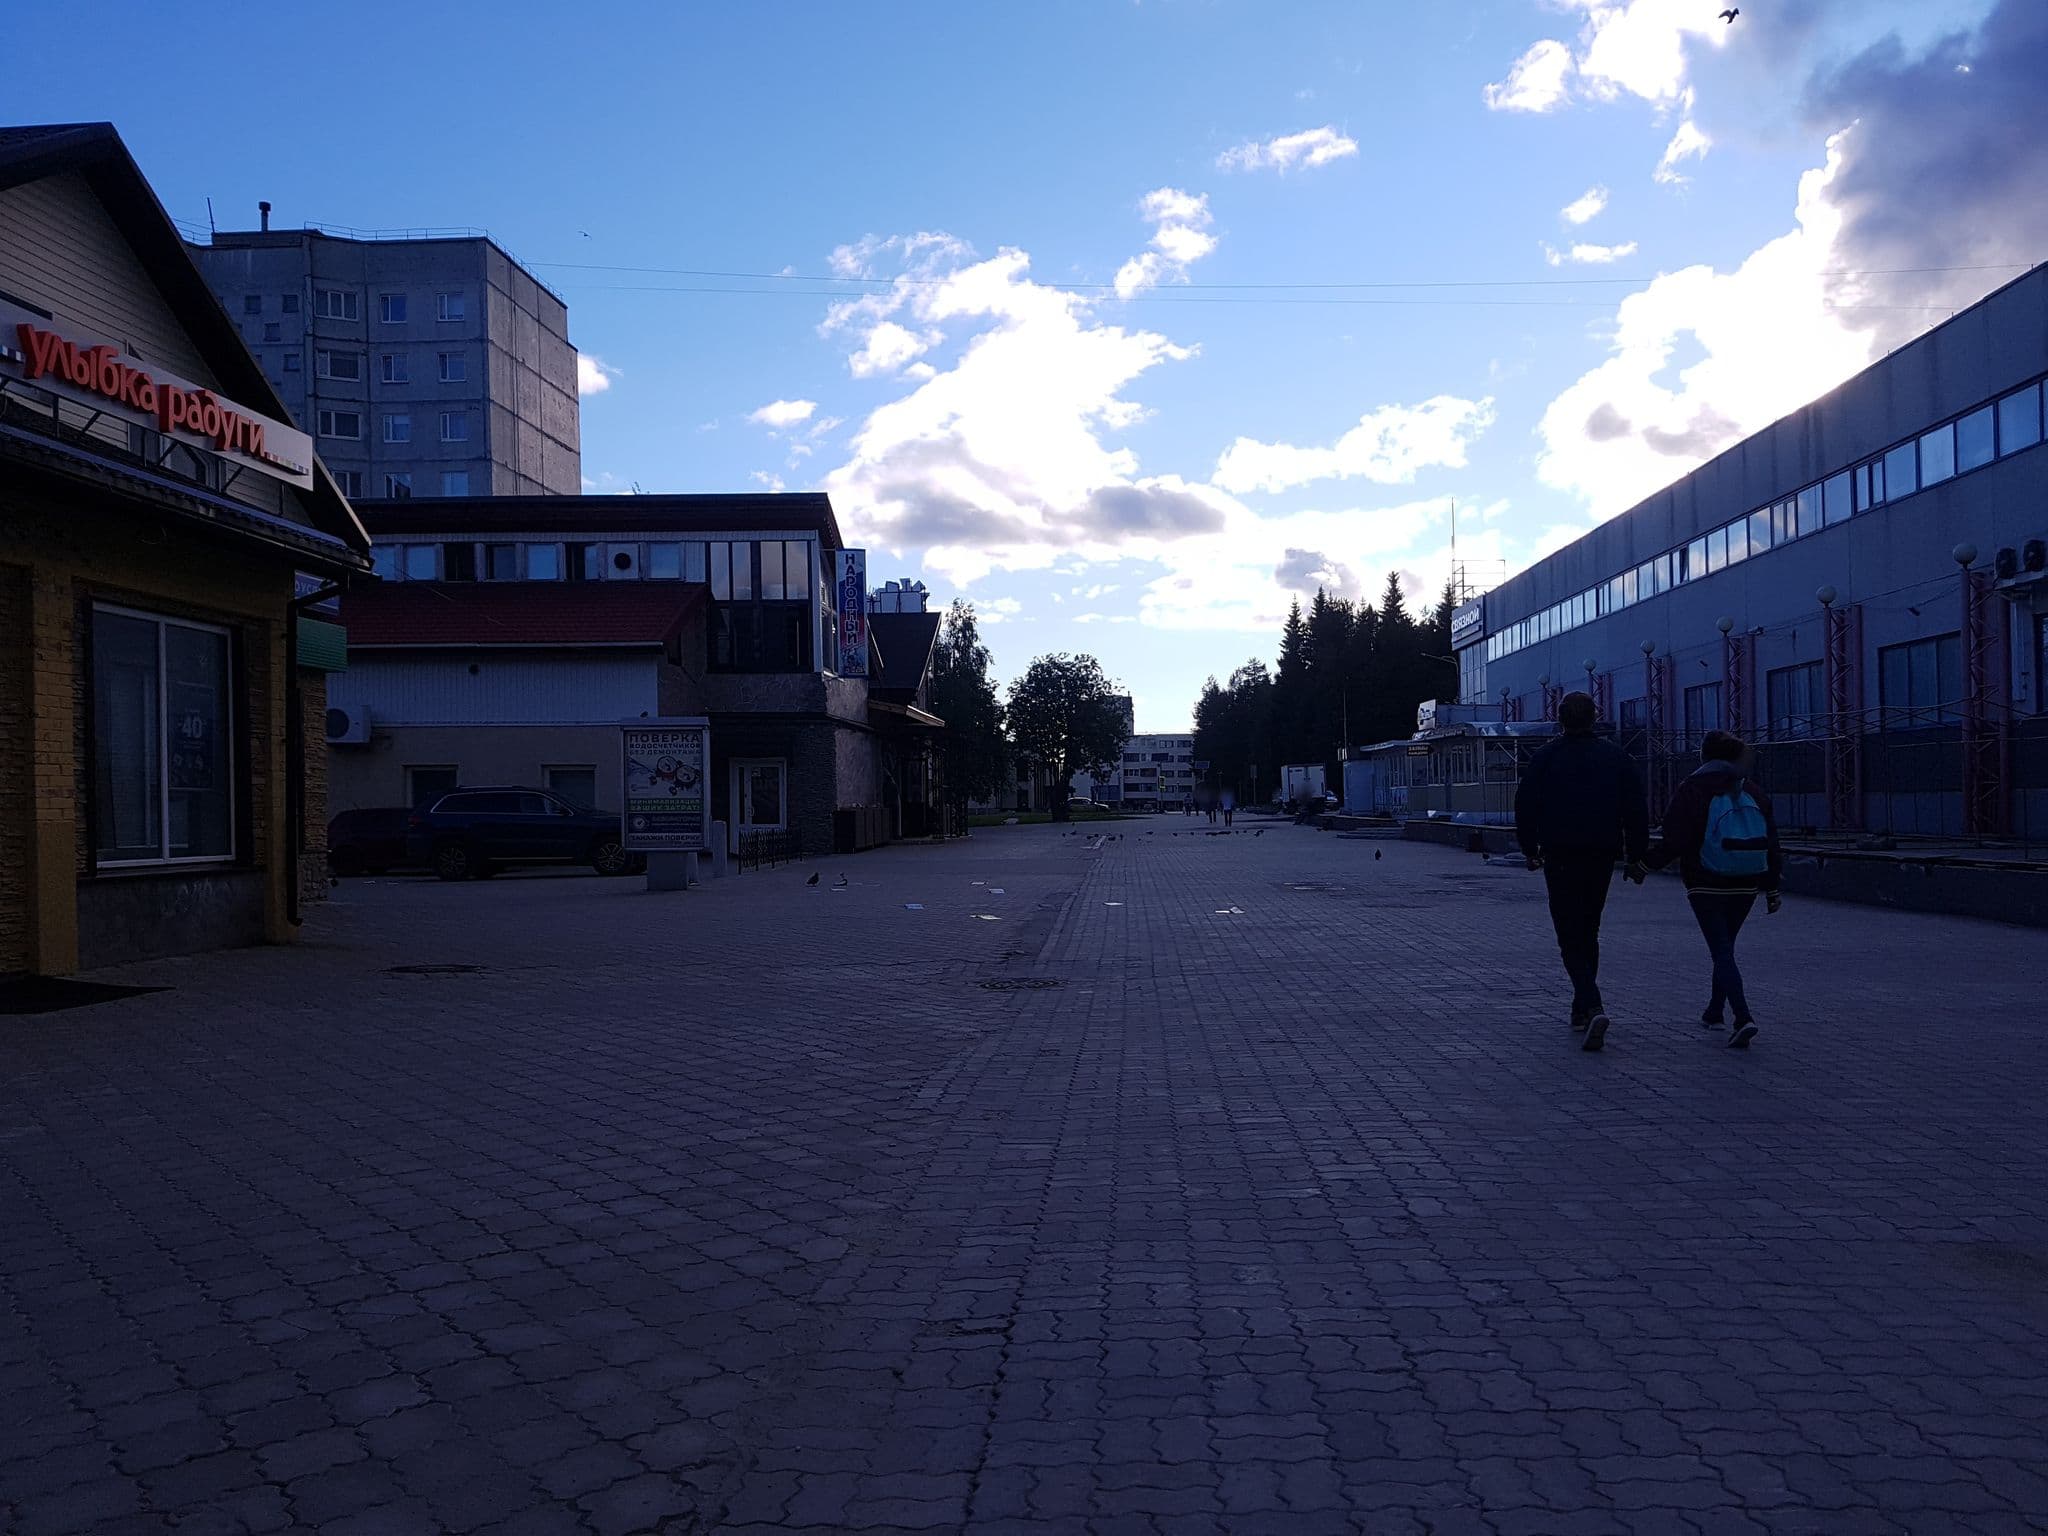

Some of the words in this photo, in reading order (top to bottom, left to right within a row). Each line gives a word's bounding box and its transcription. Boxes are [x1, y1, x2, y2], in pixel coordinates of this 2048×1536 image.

[17, 323, 160, 415] улыбка
[160, 383, 267, 461] радуги
[845, 553, 859, 645] НАРОДНЫЙ
[629, 734, 700, 743] ПОВЕРКА
